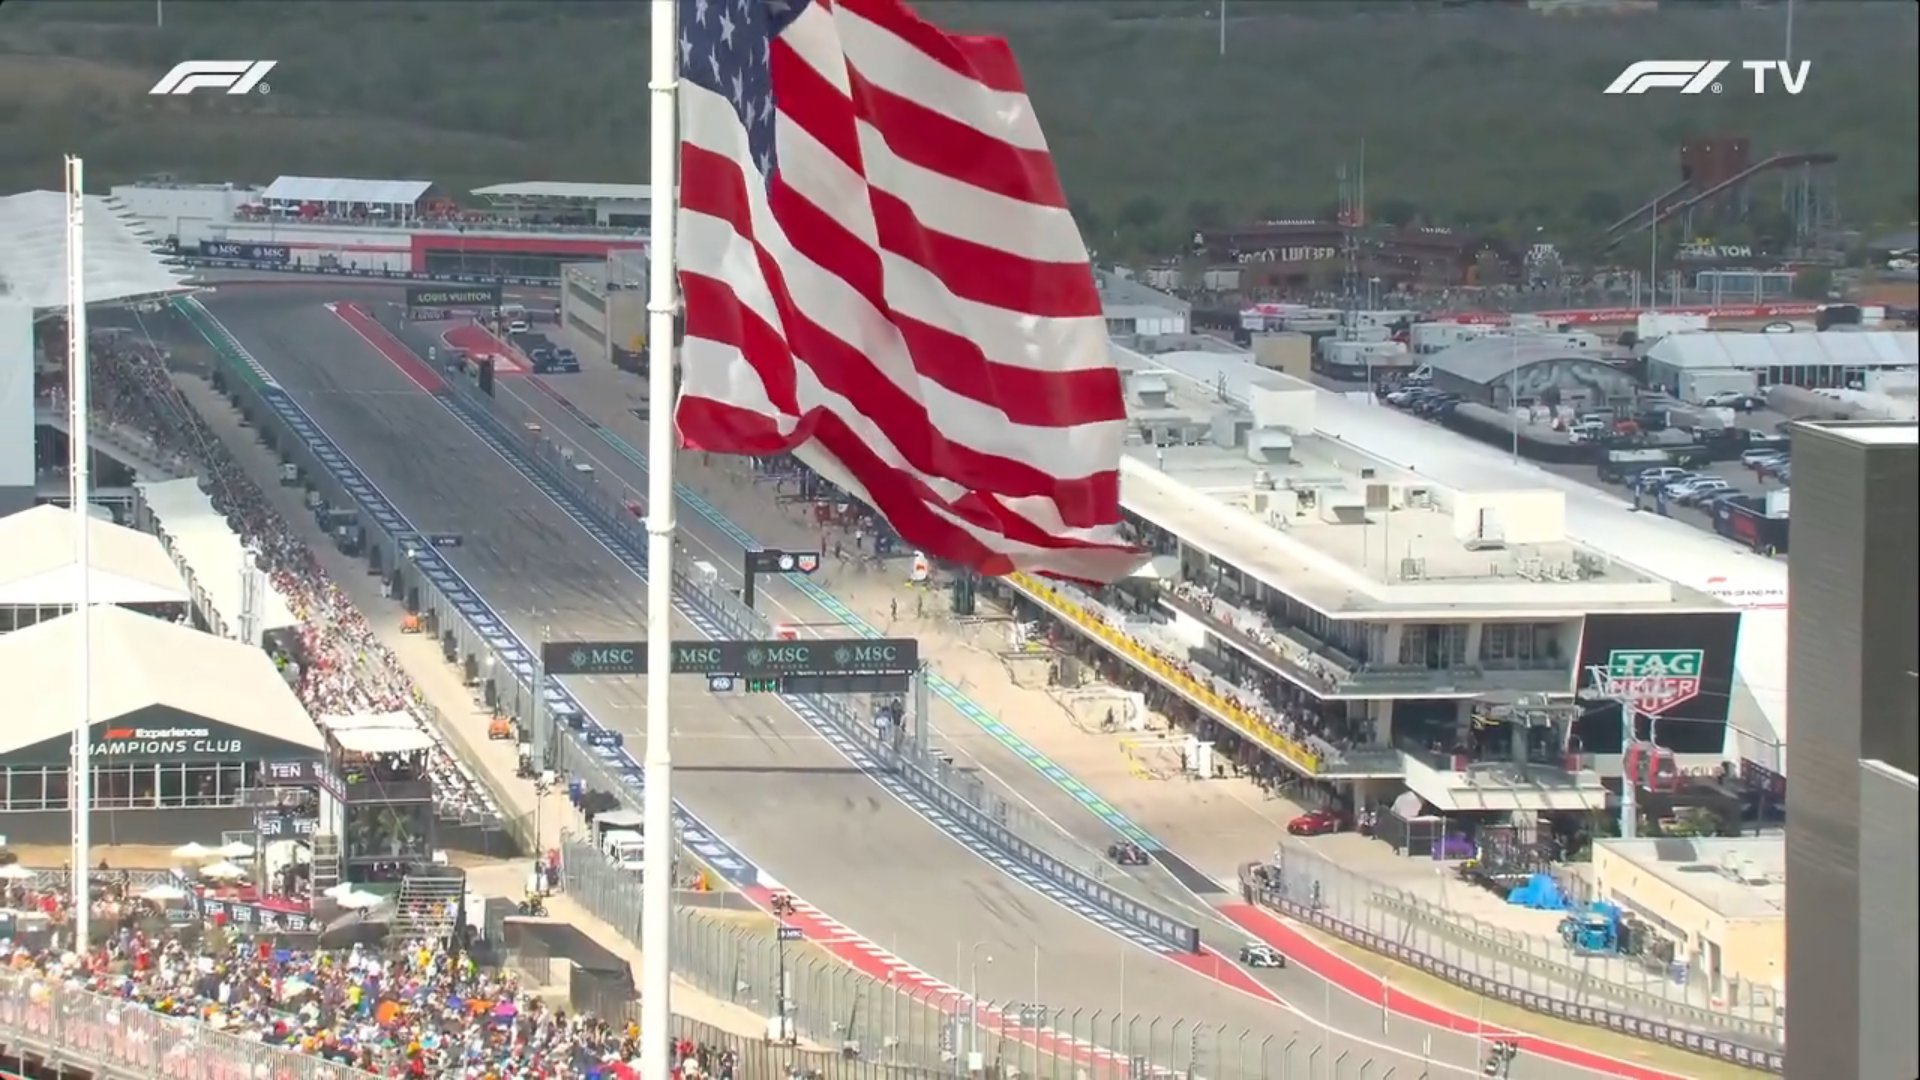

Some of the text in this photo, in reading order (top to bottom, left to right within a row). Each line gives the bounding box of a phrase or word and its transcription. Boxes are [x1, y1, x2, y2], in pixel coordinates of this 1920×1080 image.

[220, 244, 240, 255] MSC
[264, 247, 284, 257] MSC
[592, 650, 634, 664] MSC
[680, 649, 721, 663] MSC
[768, 648, 809, 662] MSC
[855, 647, 896, 661] MSC
[1617, 654, 1694, 675] TAG
[135, 728, 209, 739] Experiences
[194, 740, 242, 753] CLUB
[271, 763, 301, 778] TEN
